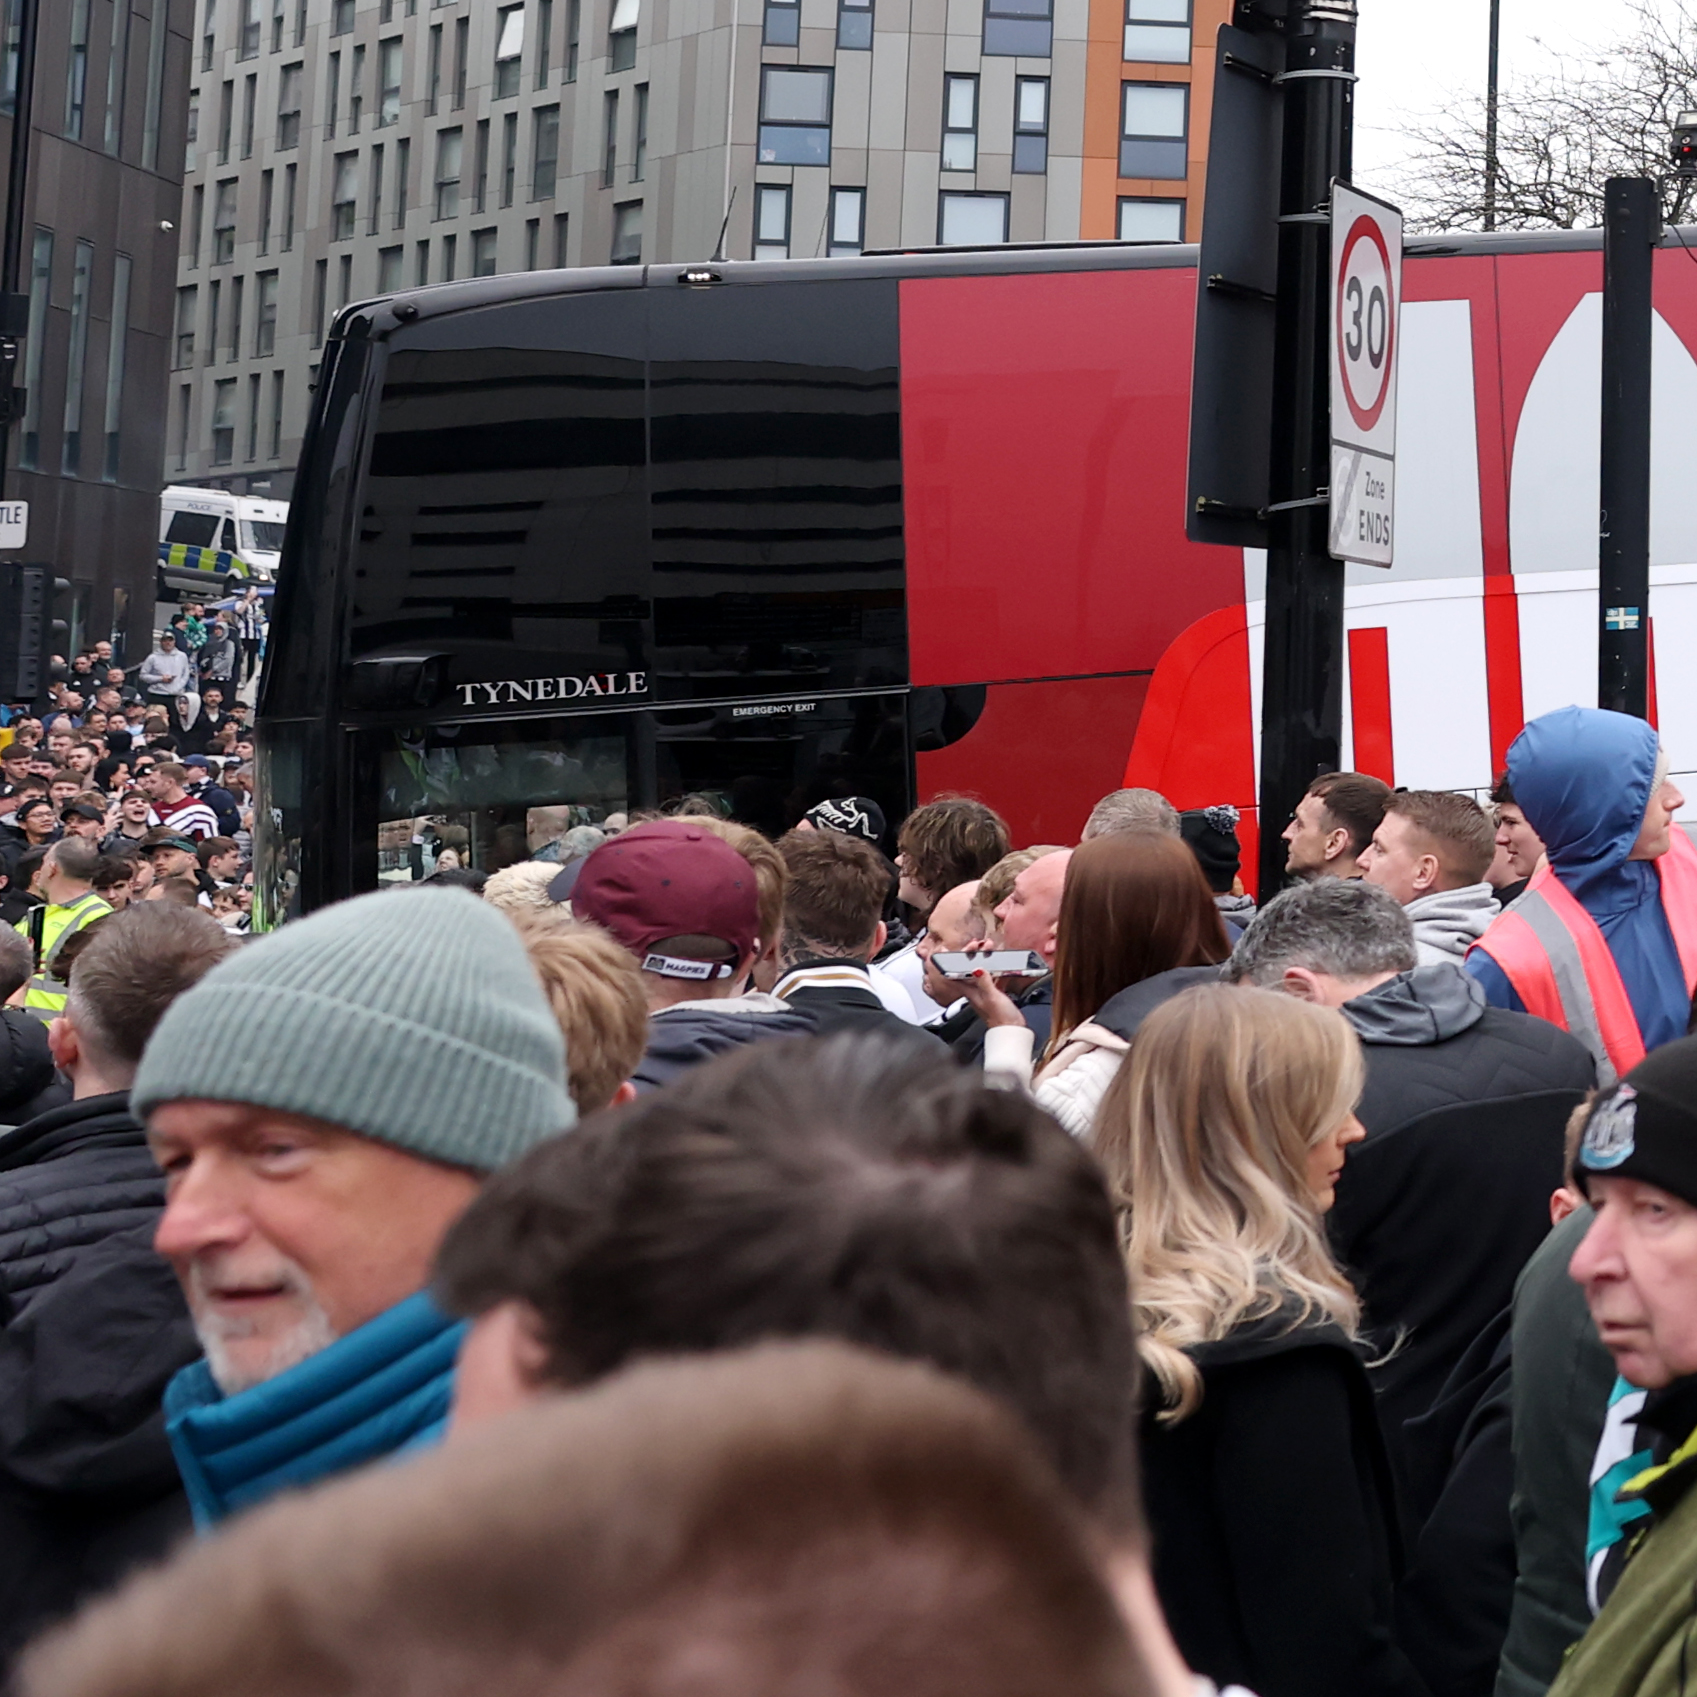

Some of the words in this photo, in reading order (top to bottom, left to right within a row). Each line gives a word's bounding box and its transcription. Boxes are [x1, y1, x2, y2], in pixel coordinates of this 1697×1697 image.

[1345, 275, 1387, 370] 30
[1365, 470, 1386, 500] Zone
[187, 502, 212, 512] POLICE
[1359, 509, 1390, 546] ENDS
[457, 671, 649, 706] TYNEDALE
[732, 704, 793, 716] EMERGENCY
[795, 703, 816, 712] EXIT
[665, 962, 706, 974] MAGPIES
